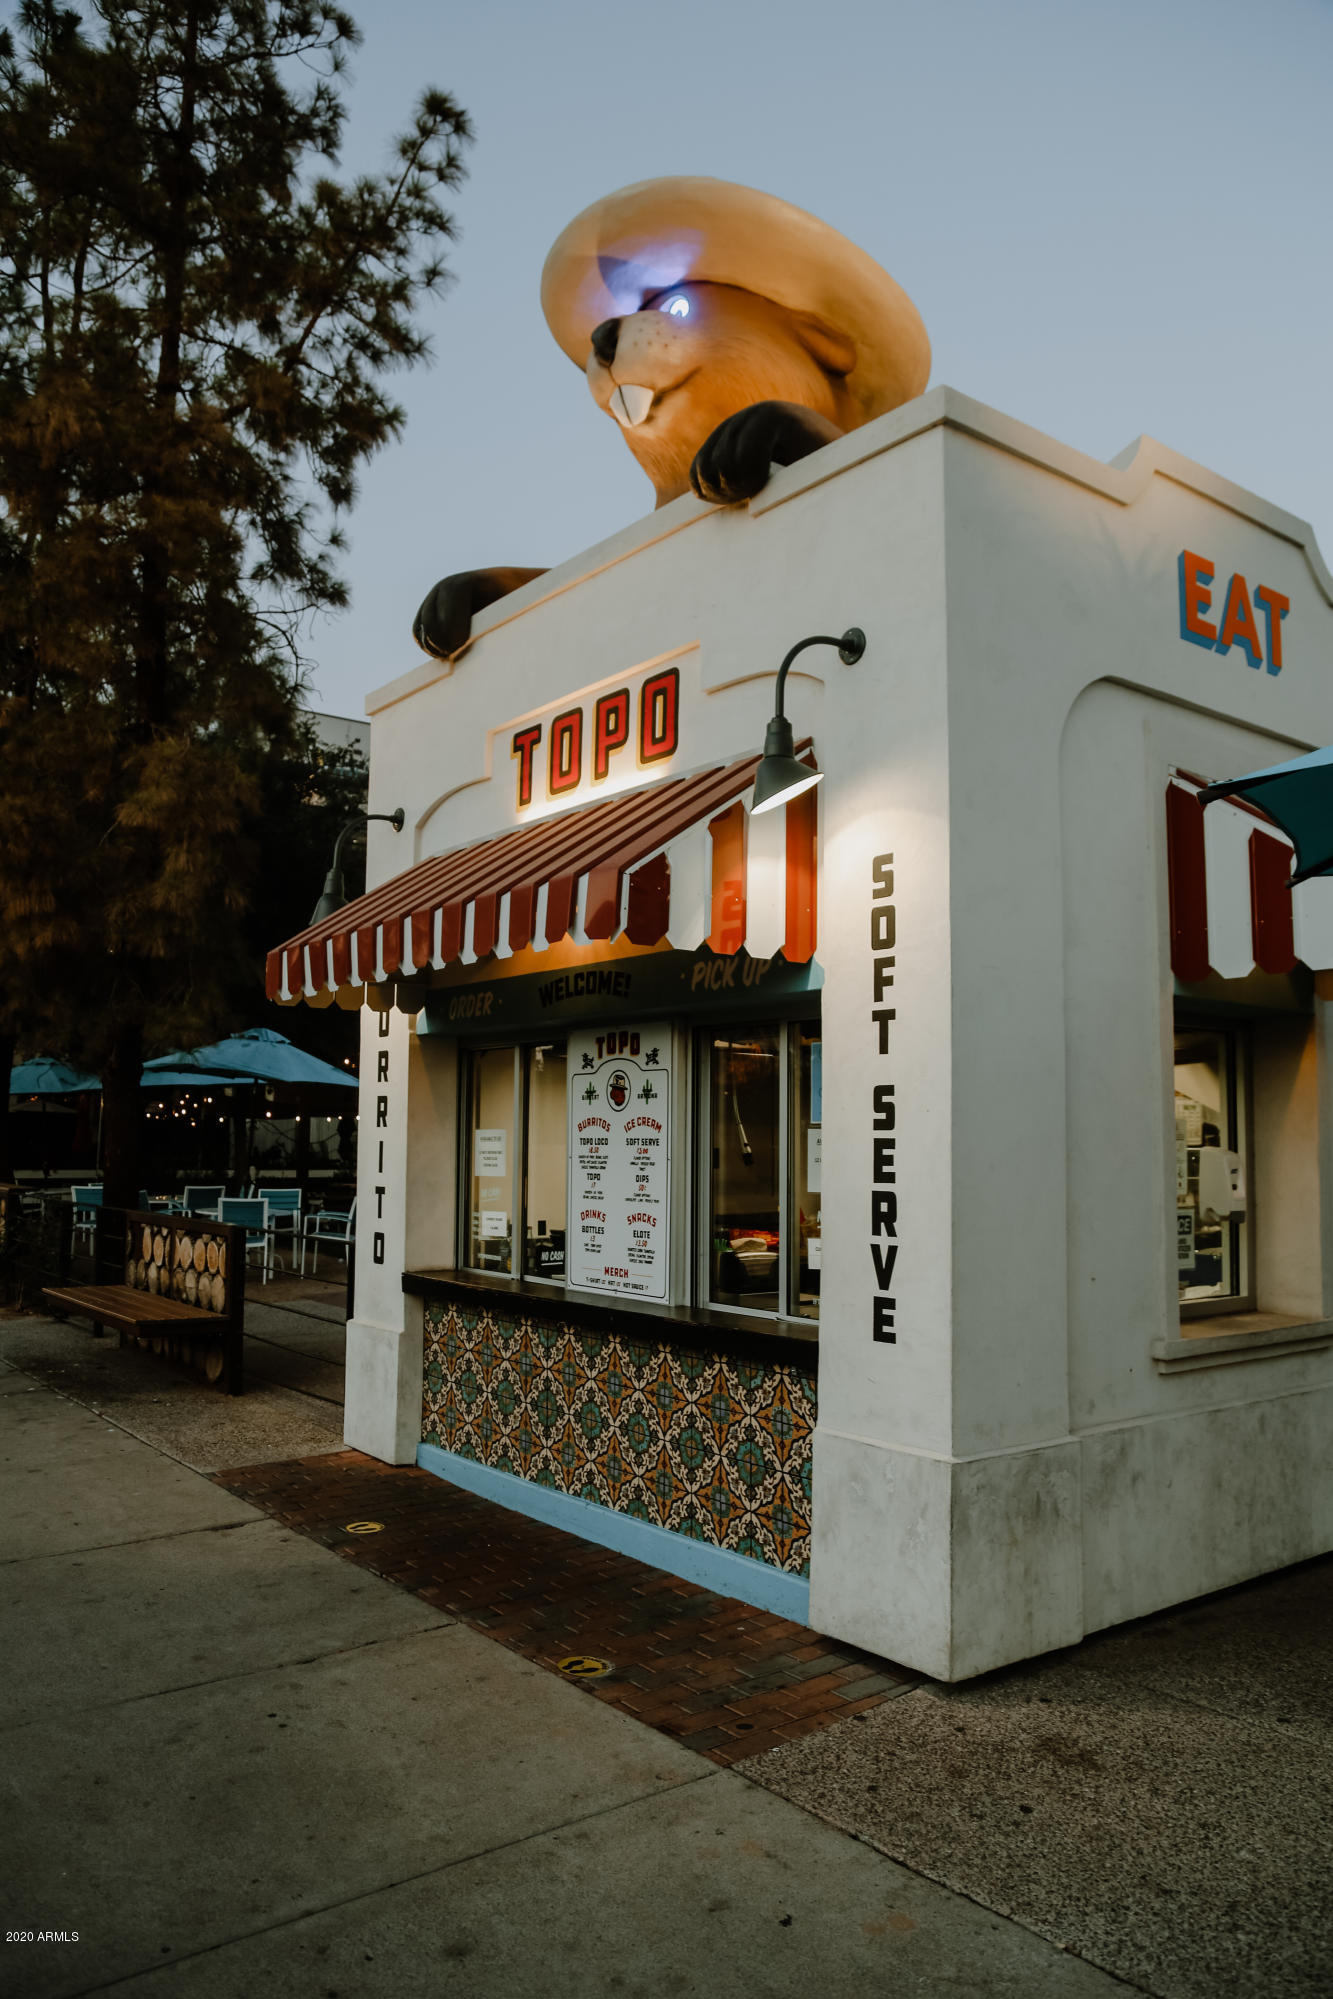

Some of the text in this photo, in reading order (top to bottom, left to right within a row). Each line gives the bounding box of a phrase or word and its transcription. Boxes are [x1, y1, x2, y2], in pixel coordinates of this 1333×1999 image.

[1178, 549, 1290, 676] EAT
[511, 667, 680, 813] TOPO
[691, 955, 772, 992] PICK UP
[538, 970, 632, 1008] WELCOME!
[449, 991, 495, 1021] ORDER
[595, 1031, 641, 1059] TOPO
[870, 852, 898, 1345] SOFT SERVE
[577, 1117, 611, 1133] BURRITOS
[624, 1116, 662, 1133] ICE CREAM
[373, 1011, 390, 1265] URRITO
[594, 1138, 608, 1146] LOCO
[626, 1138, 660, 1146] SOFT SERVE
[587, 1173, 600, 1181] TOPO
[635, 1174, 649, 1183] DIPS
[580, 1209, 607, 1223] DRINKS
[627, 1212, 657, 1228] SNACKS
[581, 1225, 605, 1235] BOTTLES
[633, 1230, 651, 1239] ELOTE
[541, 1250, 565, 1261] NO CASH
[604, 1266, 629, 1278] MERCH
